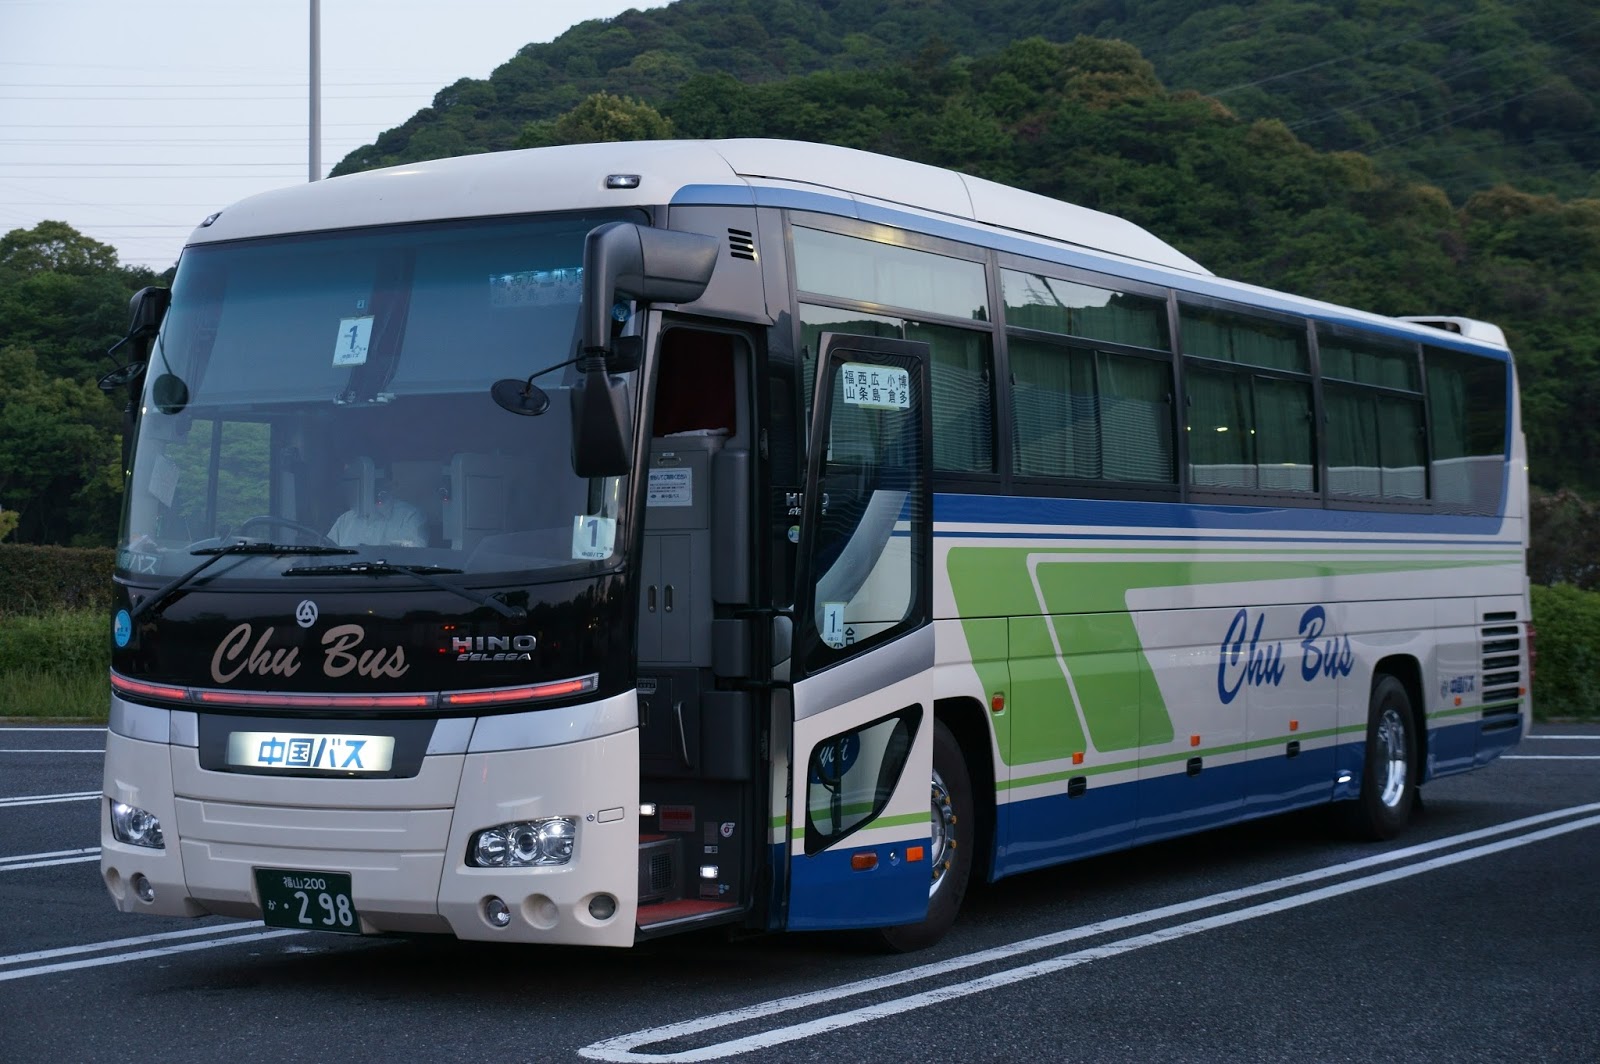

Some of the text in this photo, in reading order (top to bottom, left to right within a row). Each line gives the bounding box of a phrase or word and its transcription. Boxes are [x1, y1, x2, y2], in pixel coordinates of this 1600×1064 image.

[350, 325, 358, 349] 1
[844, 370, 855, 400] 福山
[857, 371, 868, 401] 西条
[871, 372, 881, 402] 広島
[887, 374, 896, 403] 小倉
[786, 492, 830, 507] HIO
[587, 520, 598, 547] 1
[830, 610, 836, 633] 1
[210, 622, 411, 684] Chu Bus
[452, 634, 537, 651] HINO
[1217, 604, 1355, 705] Chu Bus
[258, 737, 365, 769] 中国バス
